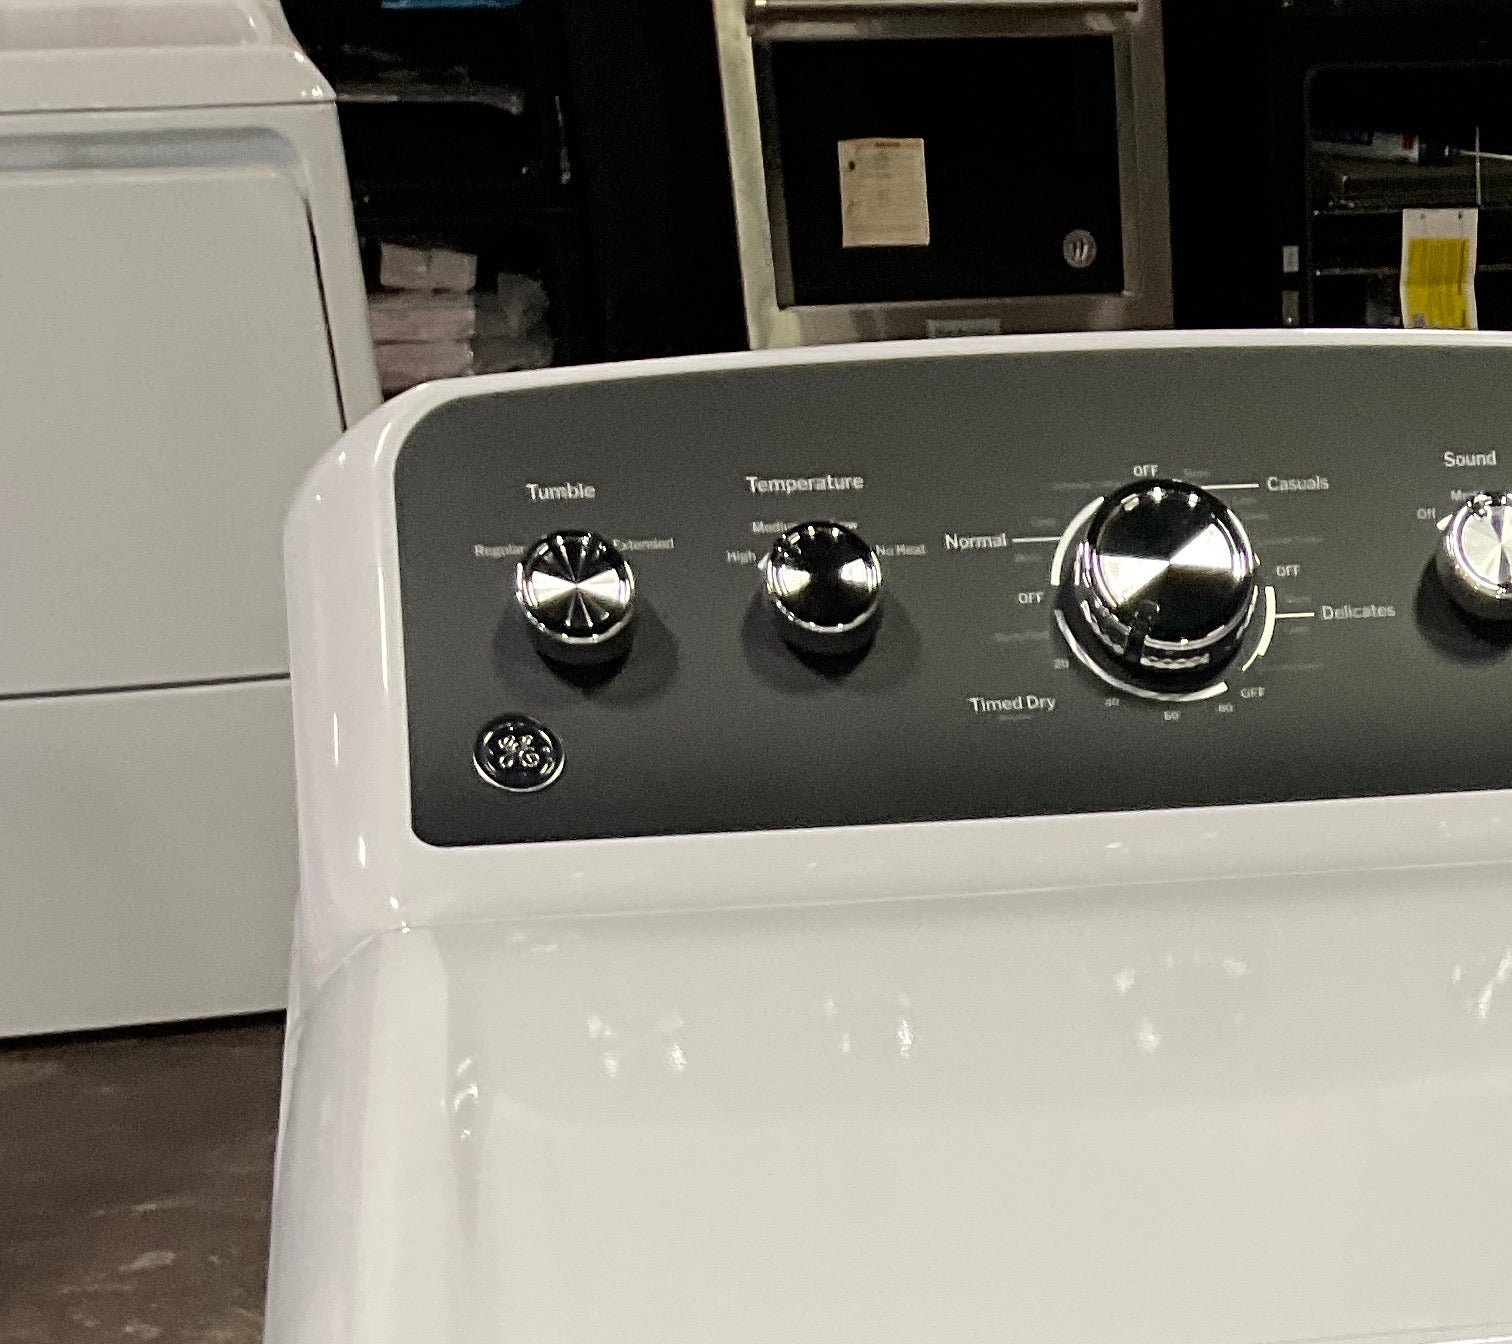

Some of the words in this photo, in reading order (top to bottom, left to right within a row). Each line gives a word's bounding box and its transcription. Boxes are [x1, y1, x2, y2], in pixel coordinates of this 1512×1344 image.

[1443, 449, 1497, 467] Sound
[525, 482, 596, 500] Tumble
[745, 475, 865, 494] Temperature
[1266, 475, 1330, 492] Casuals
[944, 532, 1007, 550] Normal
[726, 550, 756, 563] High
[1321, 605, 1397, 621] Delicates
[969, 696, 1023, 712] Timed
[1026, 694, 1056, 711] Dry
